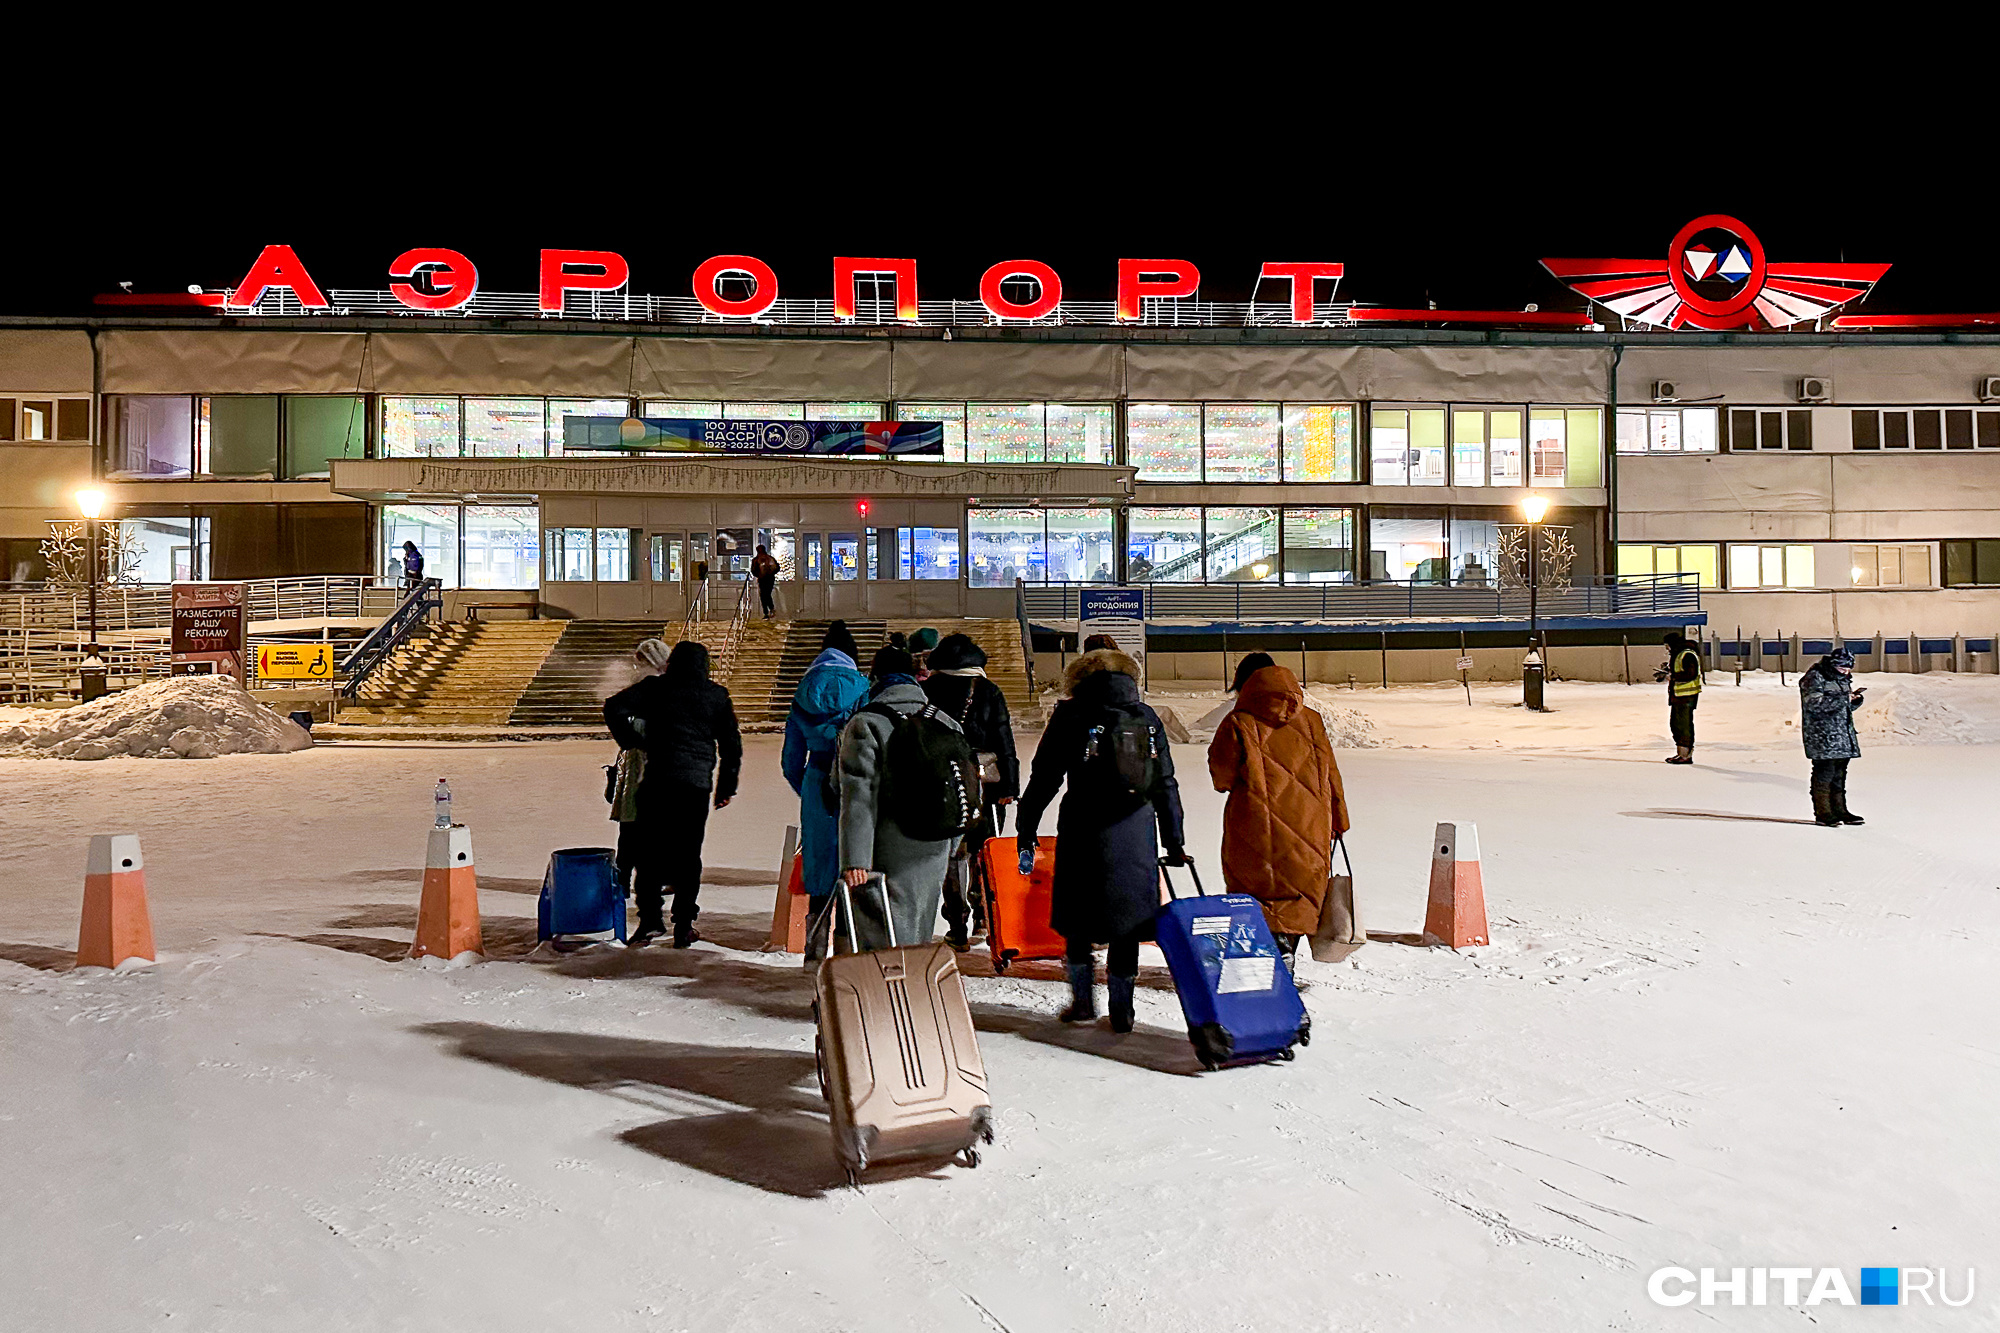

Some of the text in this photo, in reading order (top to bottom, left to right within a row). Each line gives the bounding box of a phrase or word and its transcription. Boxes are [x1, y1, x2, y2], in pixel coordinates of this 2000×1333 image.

[227, 244, 1345, 322] АЭРОПОРТ
[704, 421, 756, 431] 100 ЛЕТ
[704, 431, 756, 441] ЯАССР
[704, 441, 756, 449] 1922-2022
[1087, 602, 1139, 610] ОРТОДОНТИЯ
[176, 609, 238, 618] РАЗМЕСТИТЕ
[194, 619, 221, 628] ВАШУ
[185, 629, 229, 638] РЕКЛАМУ
